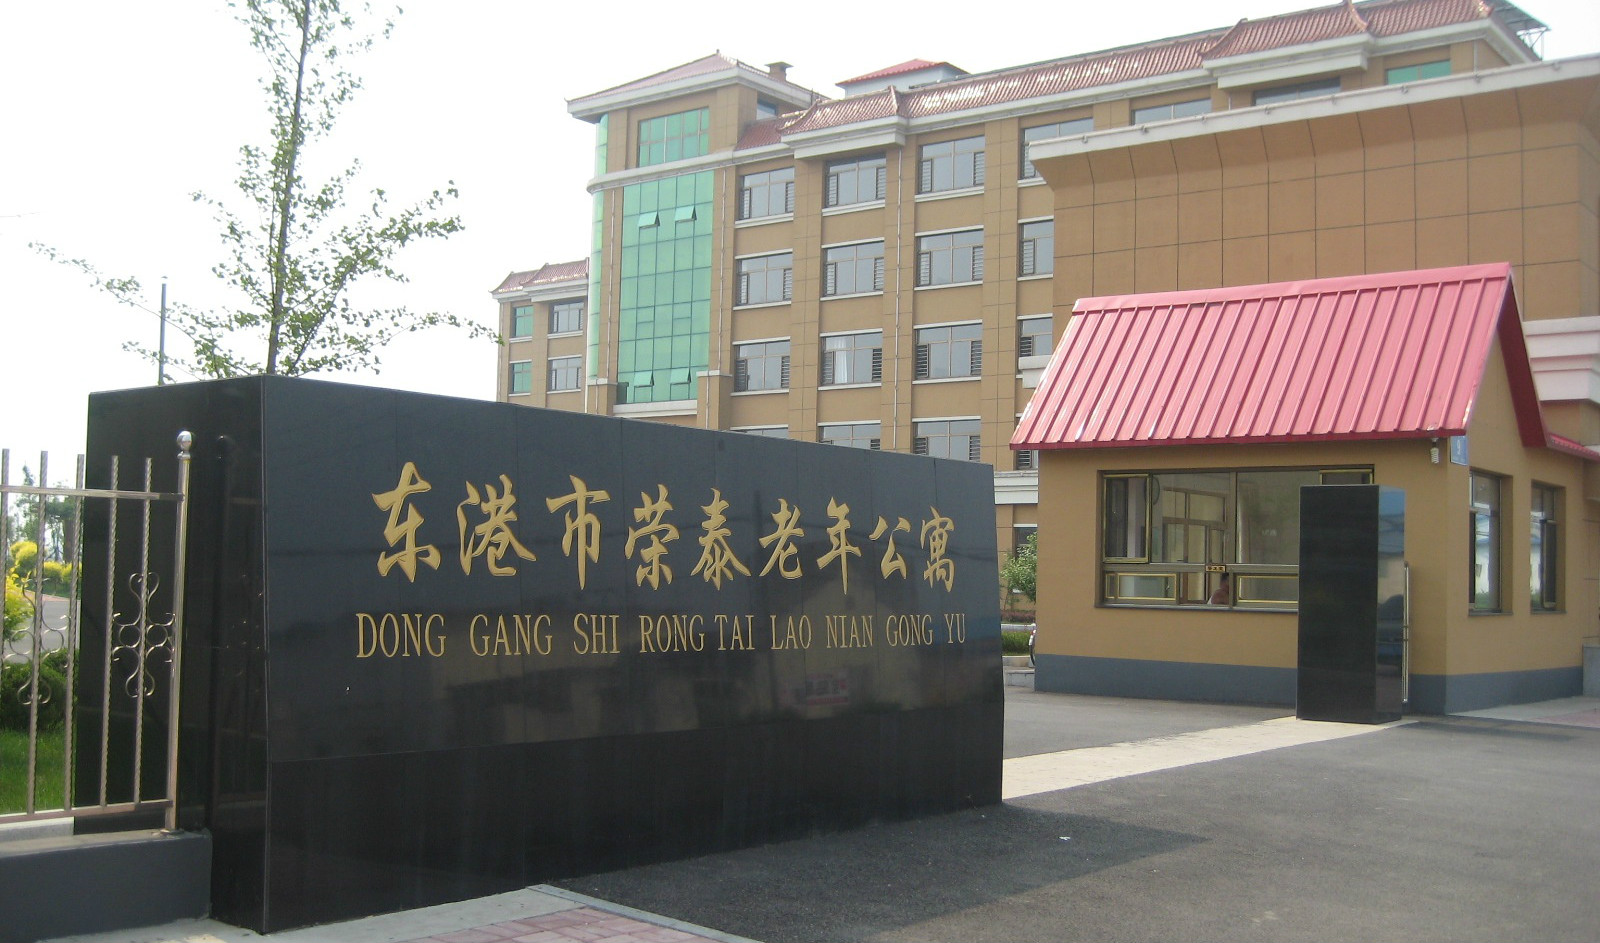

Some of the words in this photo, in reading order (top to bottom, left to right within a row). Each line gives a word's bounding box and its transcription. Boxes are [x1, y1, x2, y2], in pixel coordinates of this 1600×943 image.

[372, 461, 956, 594] 东港市荣泰老年公寓
[355, 613, 447, 658] DONG
[469, 614, 553, 657] GANG
[572, 613, 621, 655] SHI
[638, 614, 705, 654] RONG
[714, 613, 756, 652] TAI
[769, 614, 813, 651] LAO
[825, 615, 874, 649] NIAN
[886, 613, 933, 647] GONG
[943, 613, 966, 645] YU
